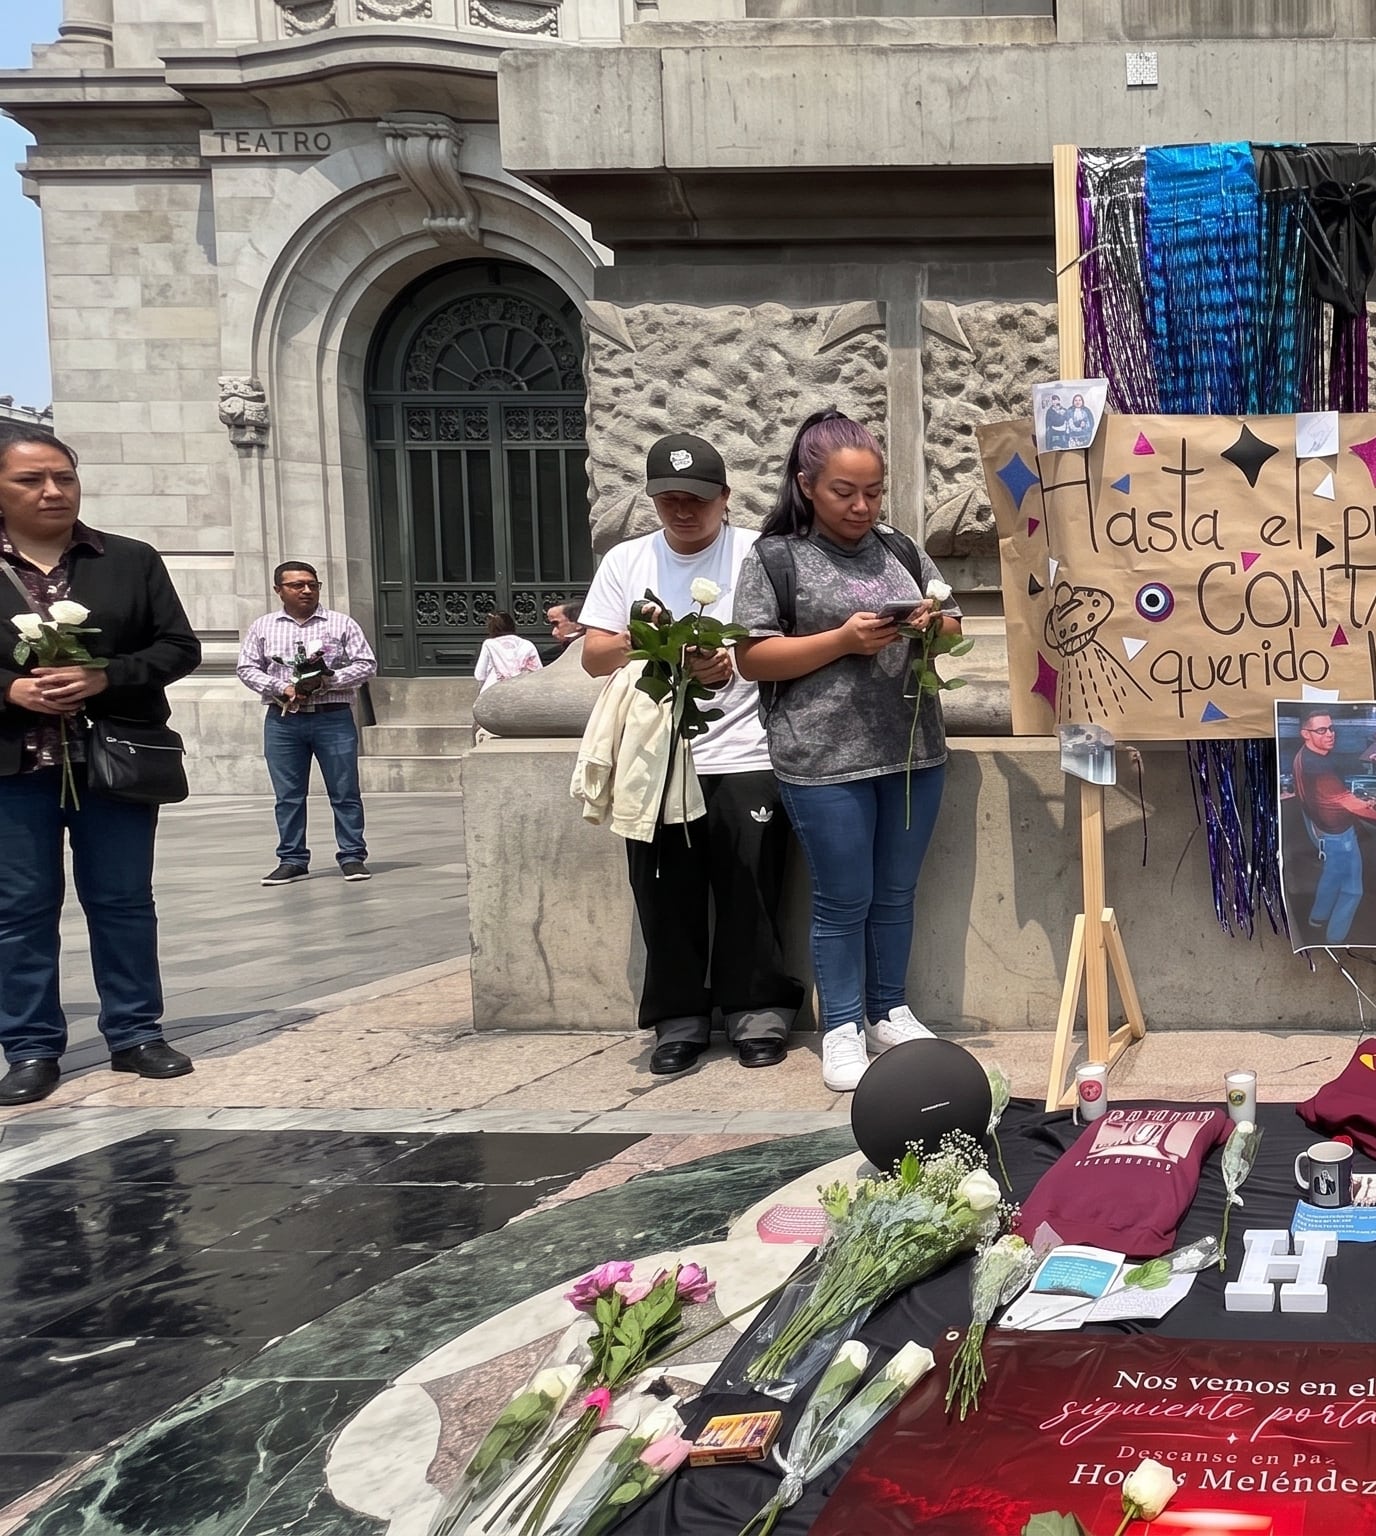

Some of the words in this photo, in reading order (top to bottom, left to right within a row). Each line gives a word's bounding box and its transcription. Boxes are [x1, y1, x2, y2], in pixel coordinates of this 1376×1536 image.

[213, 131, 331, 153] TEATRO
[1035, 437, 1225, 554] Hasta
[1259, 457, 1303, 551] el
[1149, 627, 1330, 719] querido
[1113, 1370, 1178, 1391] Nos
[1188, 1376, 1290, 1395] vemos
[1300, 1380, 1337, 1396] en
[1348, 1377, 1376, 1397] el
[1039, 1392, 1255, 1446] siguiente
[1117, 1446, 1238, 1464] Descanse
[1251, 1455, 1280, 1466] en
[1069, 1463, 1187, 1486] Hos
